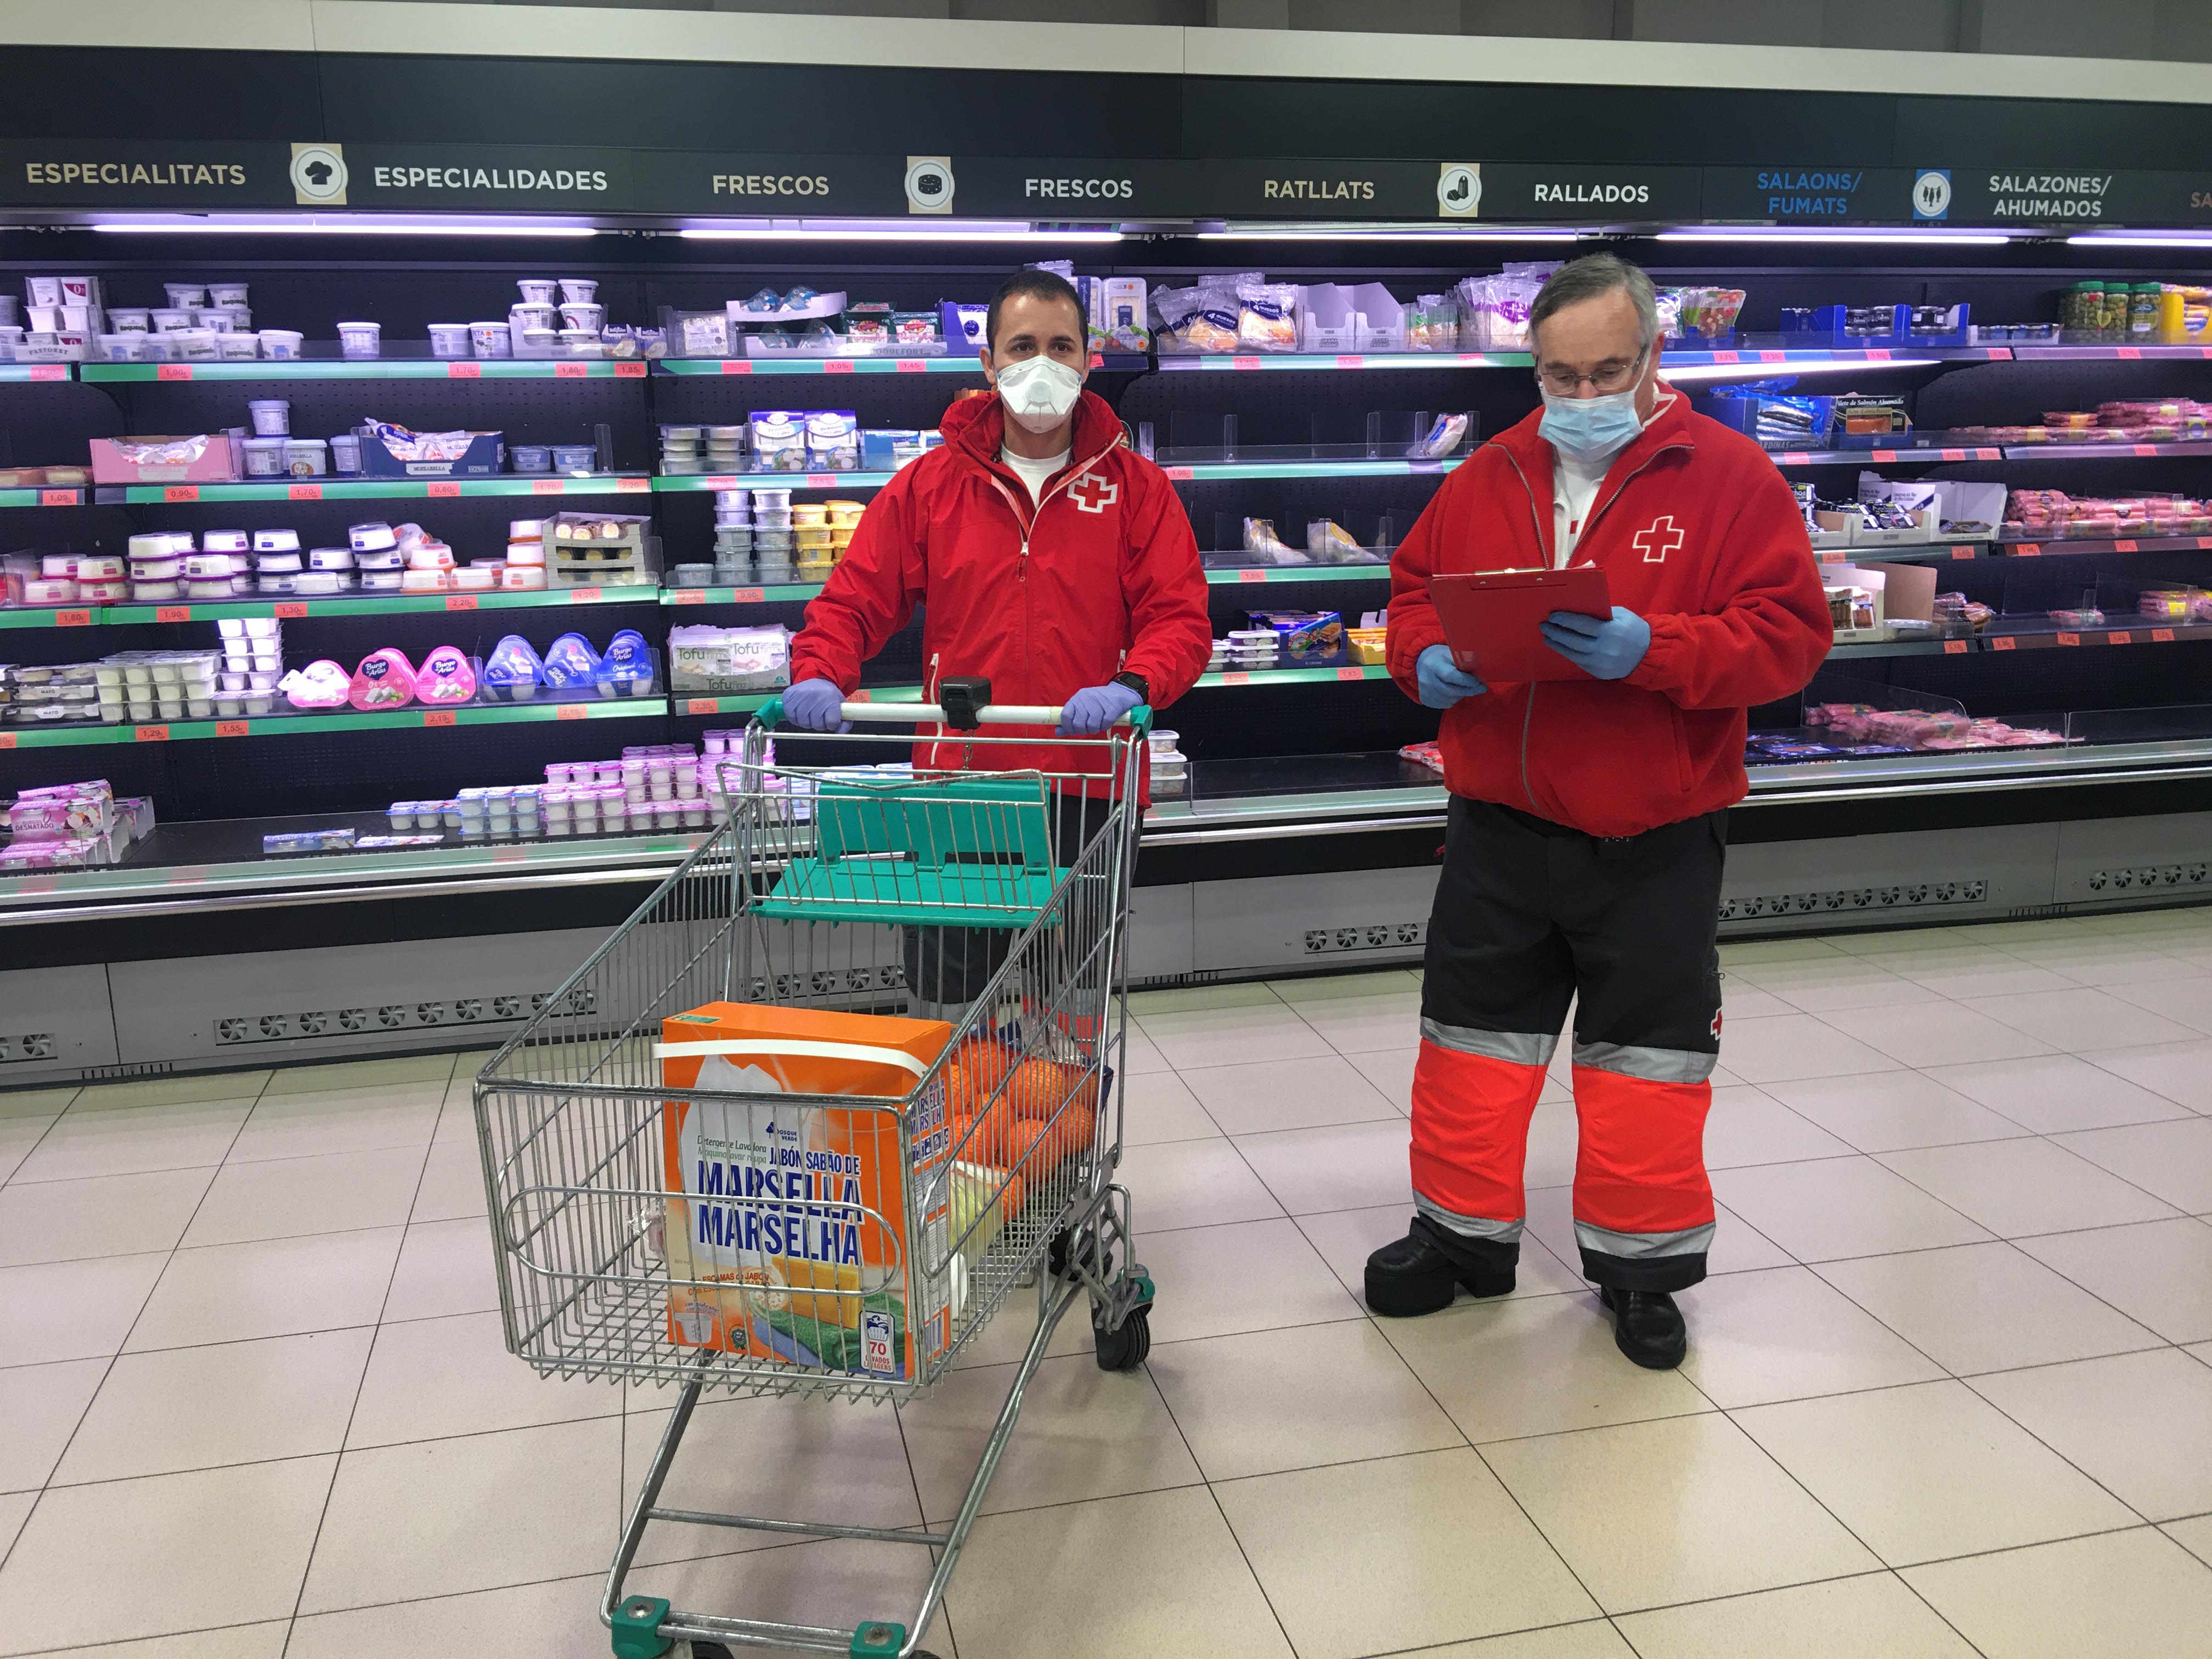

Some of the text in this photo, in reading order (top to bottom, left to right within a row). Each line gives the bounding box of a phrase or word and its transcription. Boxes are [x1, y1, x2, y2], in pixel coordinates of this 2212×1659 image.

[27, 163, 246, 185] ESPECIALITATS
[375, 167, 607, 191] ESPECIALIDADES
[713, 175, 830, 195] FRESCOS
[1757, 172, 1863, 193] SALAONS/
[1989, 176, 2112, 195] SALAZONES/
[1025, 179, 1133, 199] FRESCOS
[1265, 180, 1374, 200] RATLLATS
[1535, 184, 1649, 203] RALLADOS
[1769, 198, 1847, 215] FUMATS
[1994, 200, 2102, 217] AHUMADOS
[1216, 314, 1236, 325] QUESOS
[29, 347, 69, 356] PASTORET
[1759, 441, 1789, 449] ARDINAS
[613, 647, 632, 656] Burgo
[676, 647, 705, 660] Tofu
[733, 642, 759, 654] Tofu
[616, 653, 632, 661] Arias
[365, 662, 386, 670] Burgo
[369, 667, 386, 677] Arias
[613, 663, 636, 672] Original
[706, 678, 731, 690] Tofu
[430, 715, 450, 723] 2,19€
[143, 730, 162, 738] 1,29€
[223, 725, 242, 733] 1,55€
[697, 1135, 734, 1149] Dtergee
[729, 1153, 746, 1161] avar
[747, 1155, 767, 1165] rupa
[806, 1150, 842, 1173] SABÃO
[845, 1156, 860, 1175] DE
[698, 1160, 862, 1222] MARSELLA
[699, 1204, 861, 1266] MARSELHA
[869, 1341, 887, 1355] 70
[864, 1361, 891, 1370] LAAGENS
[865, 1355, 890, 1364] LVADOS
